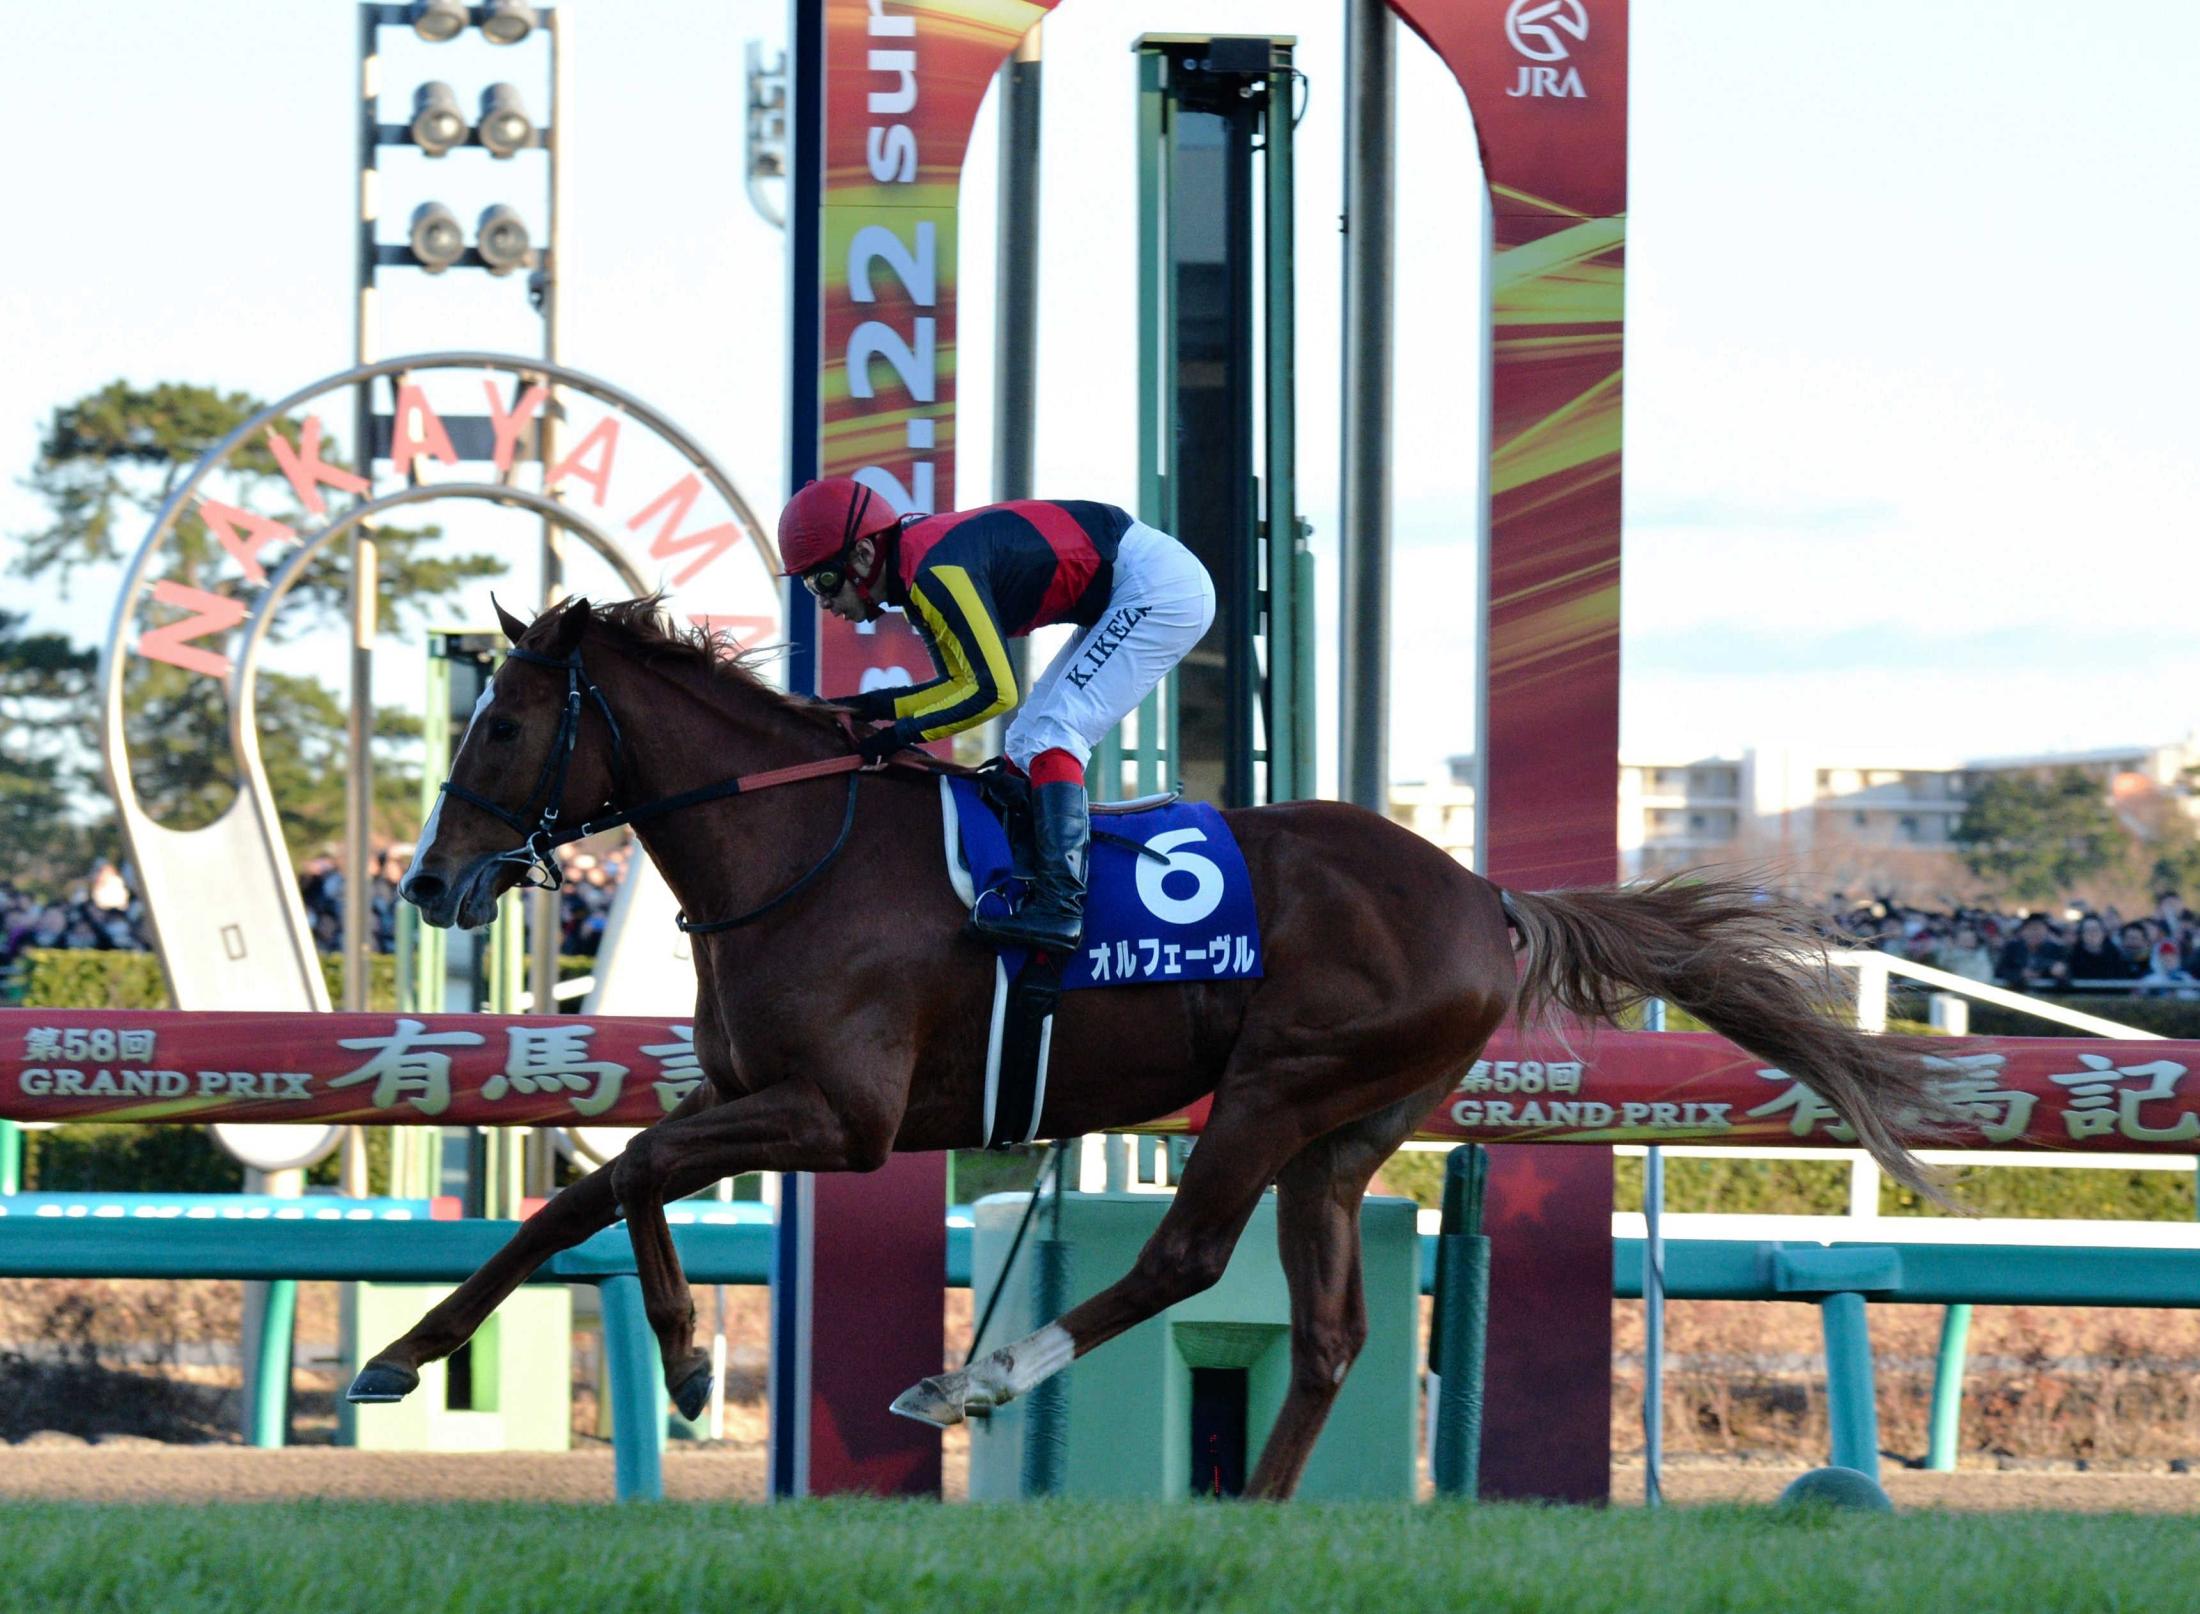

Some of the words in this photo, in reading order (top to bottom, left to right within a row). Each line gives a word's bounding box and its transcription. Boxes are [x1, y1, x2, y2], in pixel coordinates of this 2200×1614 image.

[1505, 66, 1588, 98] JRA
[137, 379, 777, 679] NAKAYAMA
[1135, 827, 1225, 925] 6
[1089, 934, 1255, 981] オルフェーヴル
[20, 1026, 157, 1063] 第58回
[19, 1068, 190, 1096] GRAND
[197, 1071, 313, 1099] PRIX
[1453, 1059, 1584, 1095] 第58回
[1451, 1100, 1616, 1127] GRAND
[1620, 1102, 1732, 1128] PRIX
